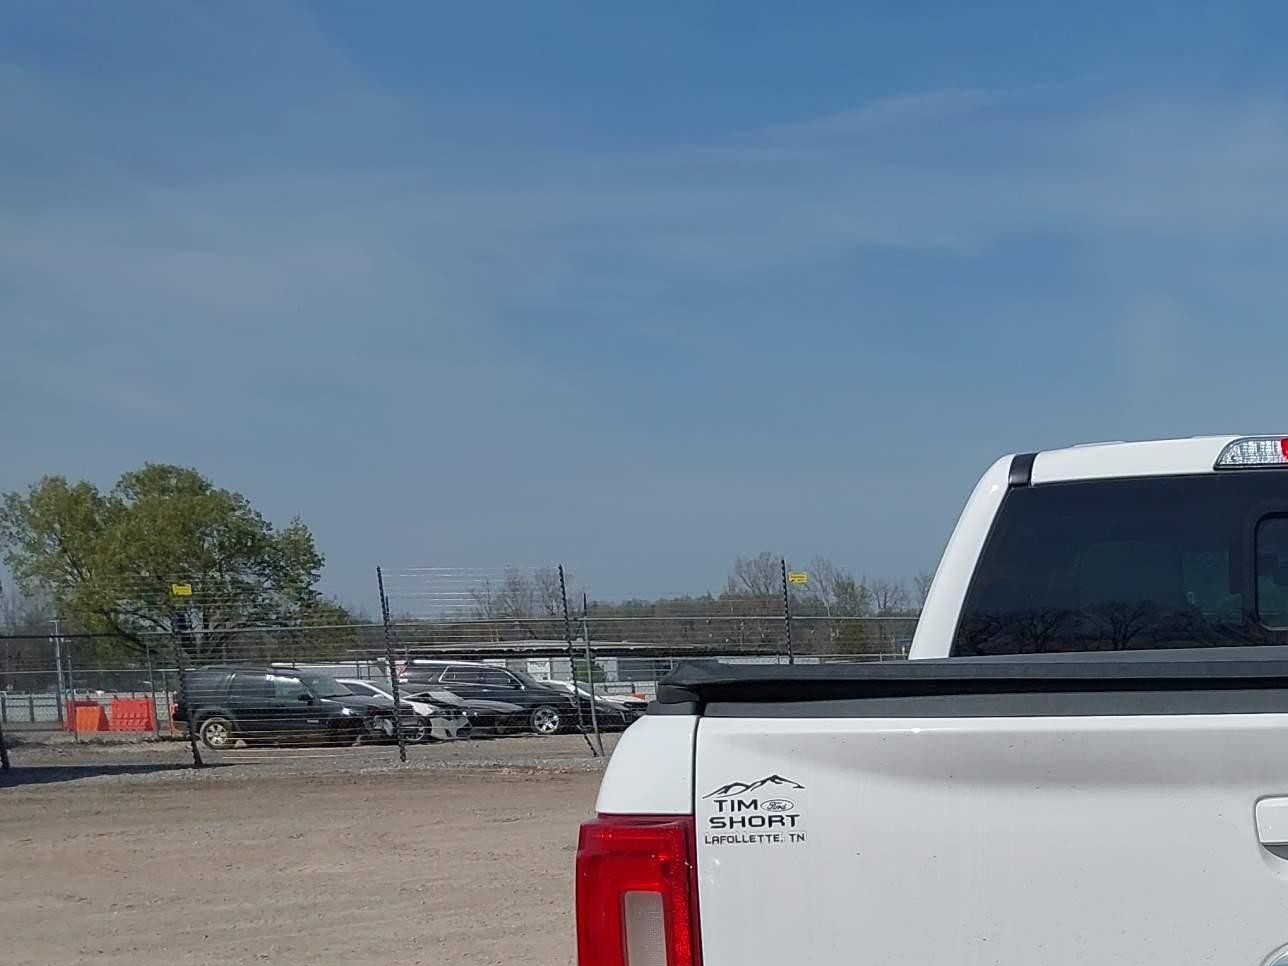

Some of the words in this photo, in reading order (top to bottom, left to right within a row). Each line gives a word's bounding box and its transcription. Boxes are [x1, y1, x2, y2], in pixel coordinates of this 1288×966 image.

[713, 799, 758, 812] TIM
[709, 814, 800, 829] SHORT
[789, 833, 805, 842] TN
